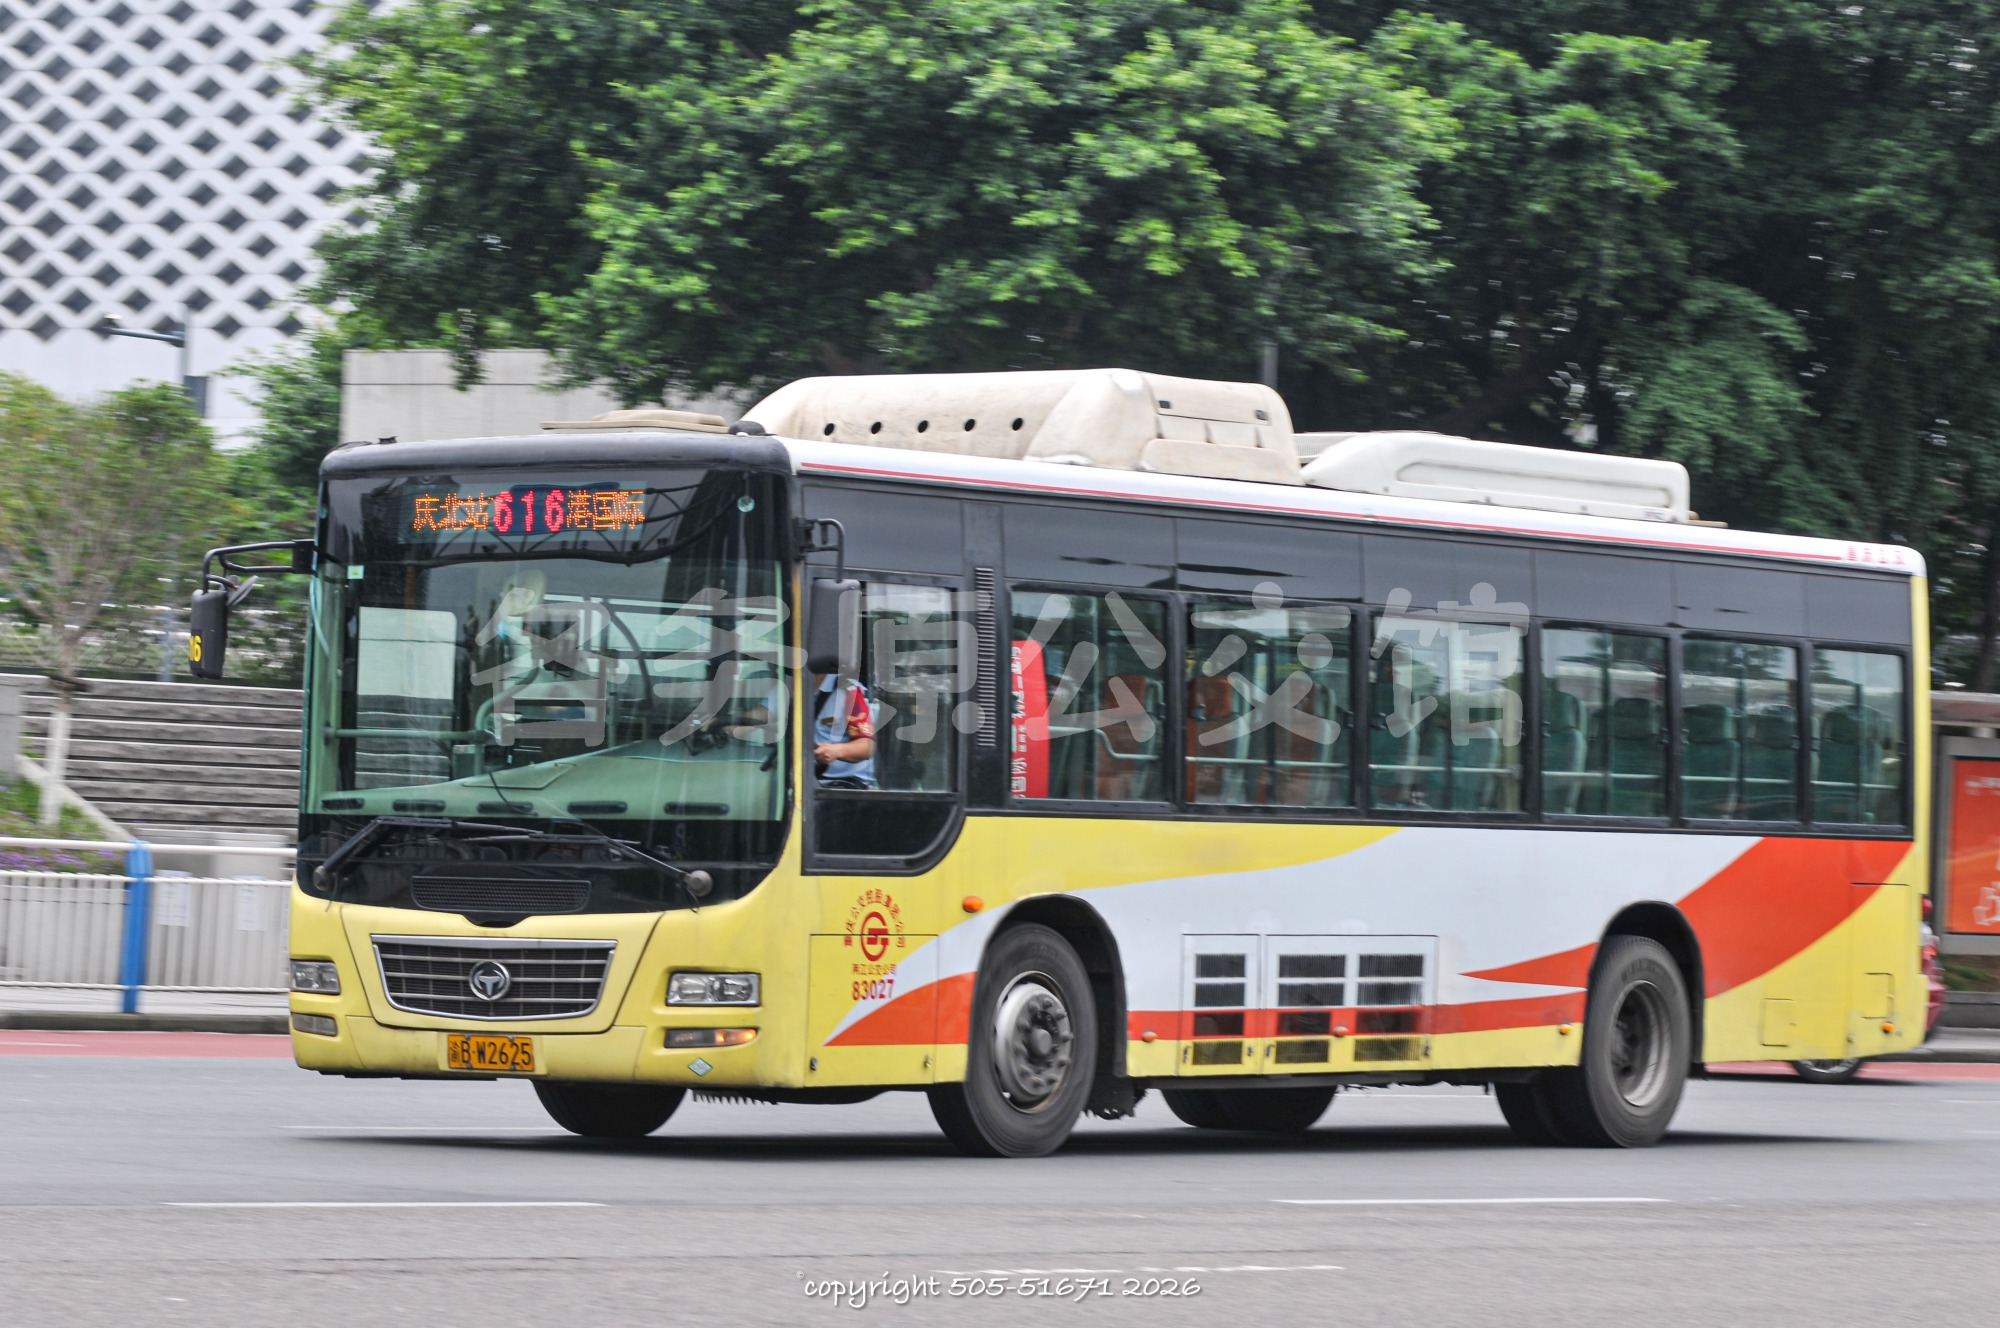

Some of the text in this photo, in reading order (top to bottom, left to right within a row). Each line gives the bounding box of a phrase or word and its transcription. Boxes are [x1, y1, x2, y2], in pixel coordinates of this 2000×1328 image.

[493, 490, 564, 532] 616
[566, 489, 646, 531] 港国际
[852, 979, 895, 1000] 83027
